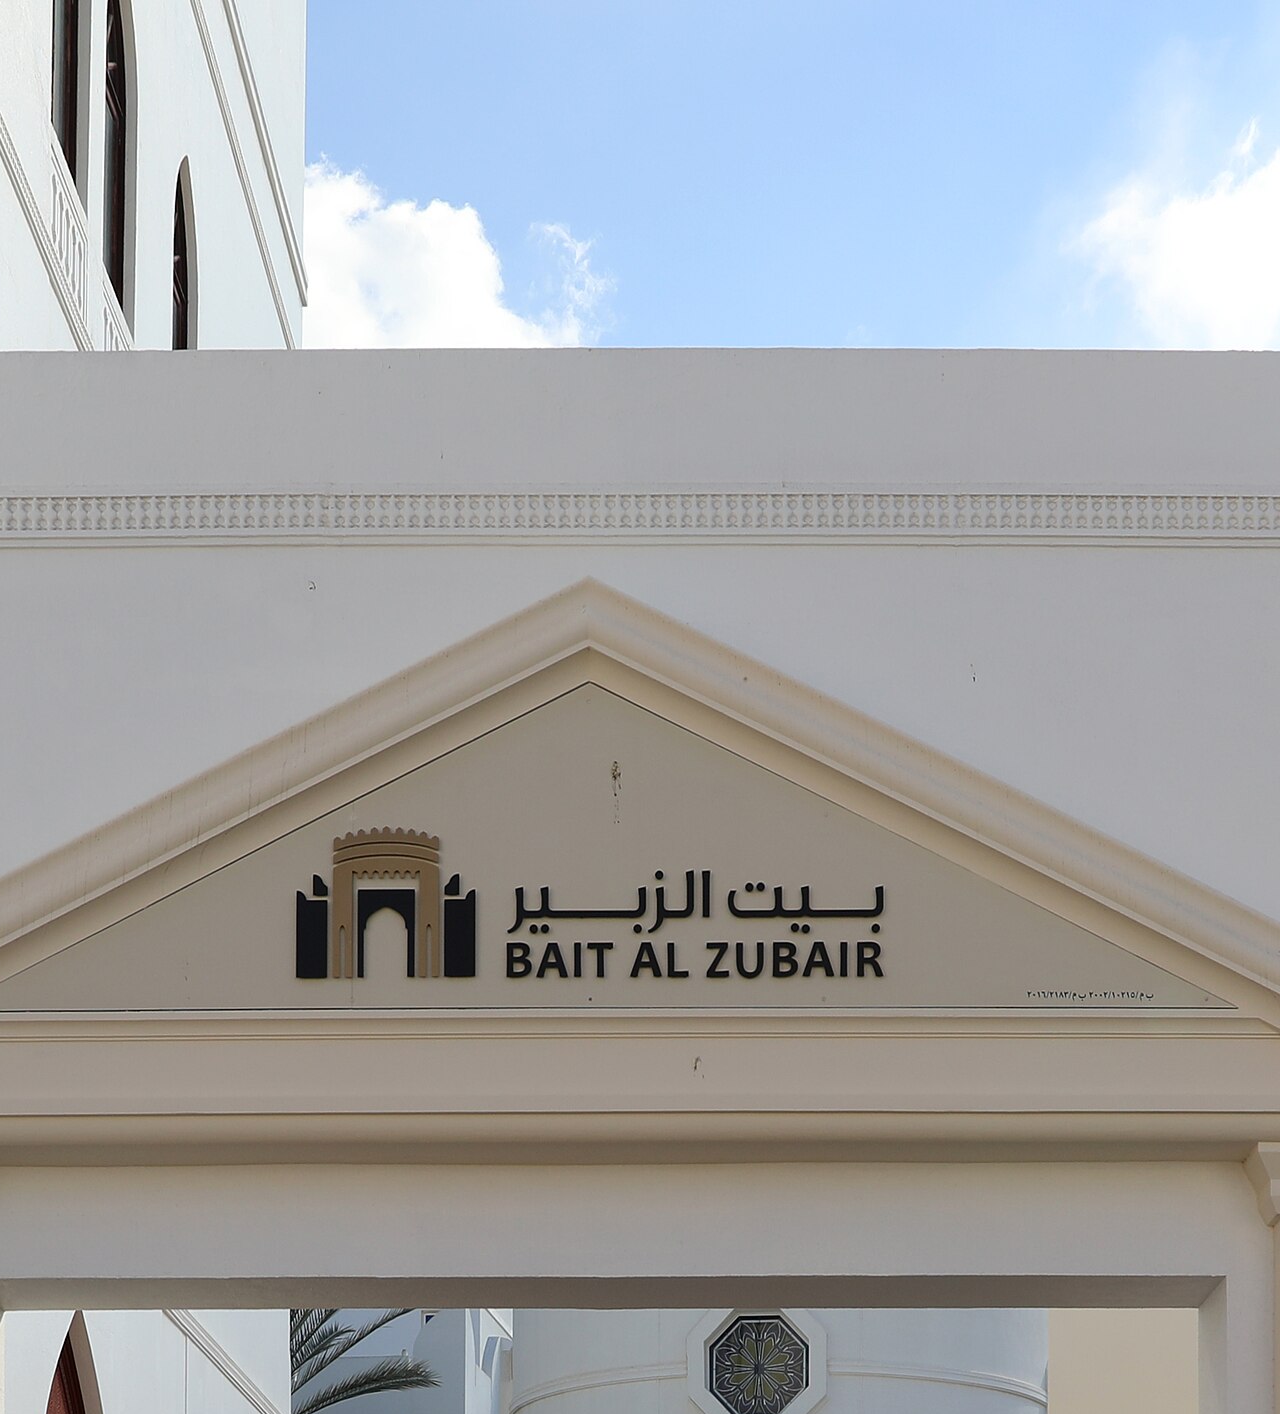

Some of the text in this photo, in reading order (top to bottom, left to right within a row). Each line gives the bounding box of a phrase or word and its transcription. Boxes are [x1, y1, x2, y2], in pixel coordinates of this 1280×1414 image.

[506, 868, 885, 934] بيت الزبير
[505, 941, 884, 978] BAIT AL ZUBAIR
